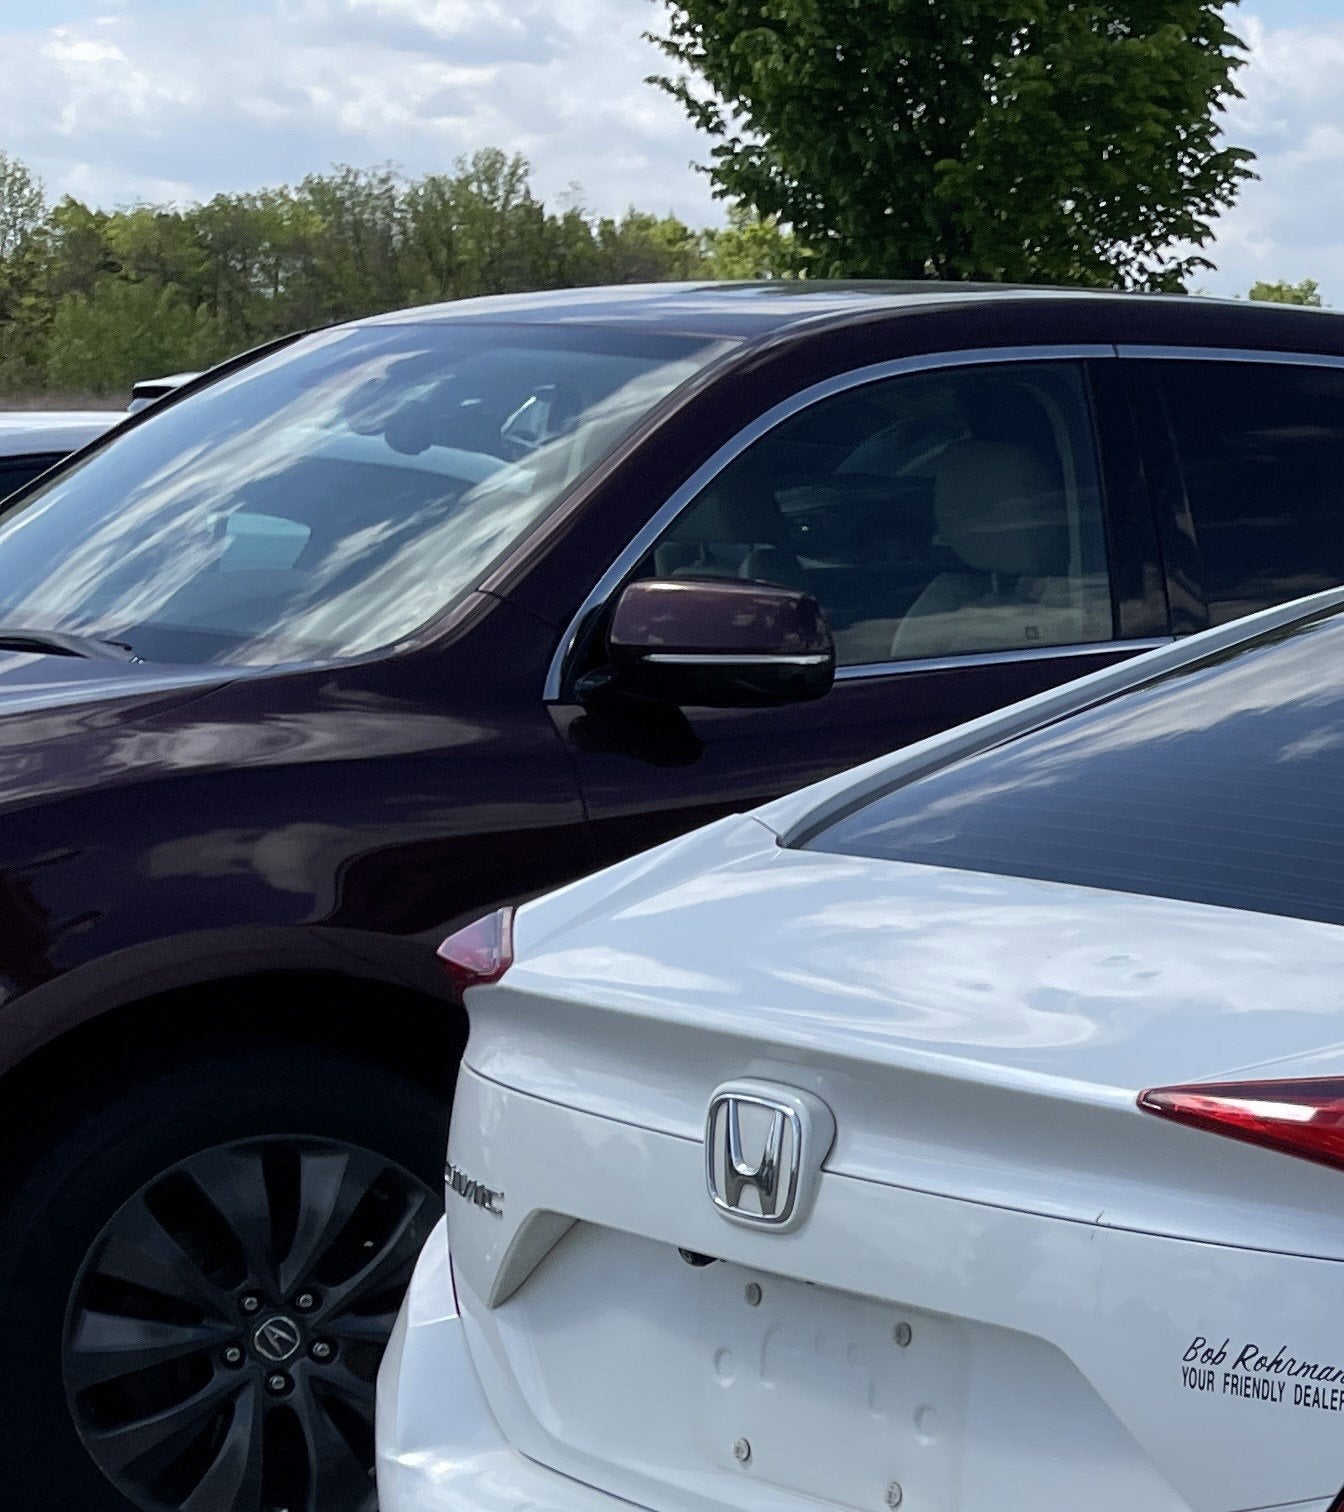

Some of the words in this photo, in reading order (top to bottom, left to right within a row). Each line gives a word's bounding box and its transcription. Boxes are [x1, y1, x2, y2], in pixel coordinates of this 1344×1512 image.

[1182, 1336, 1231, 1366] Bob
[1181, 1366, 1215, 1392] YOUR
[1223, 1372, 1286, 1403] FRIENDLY
